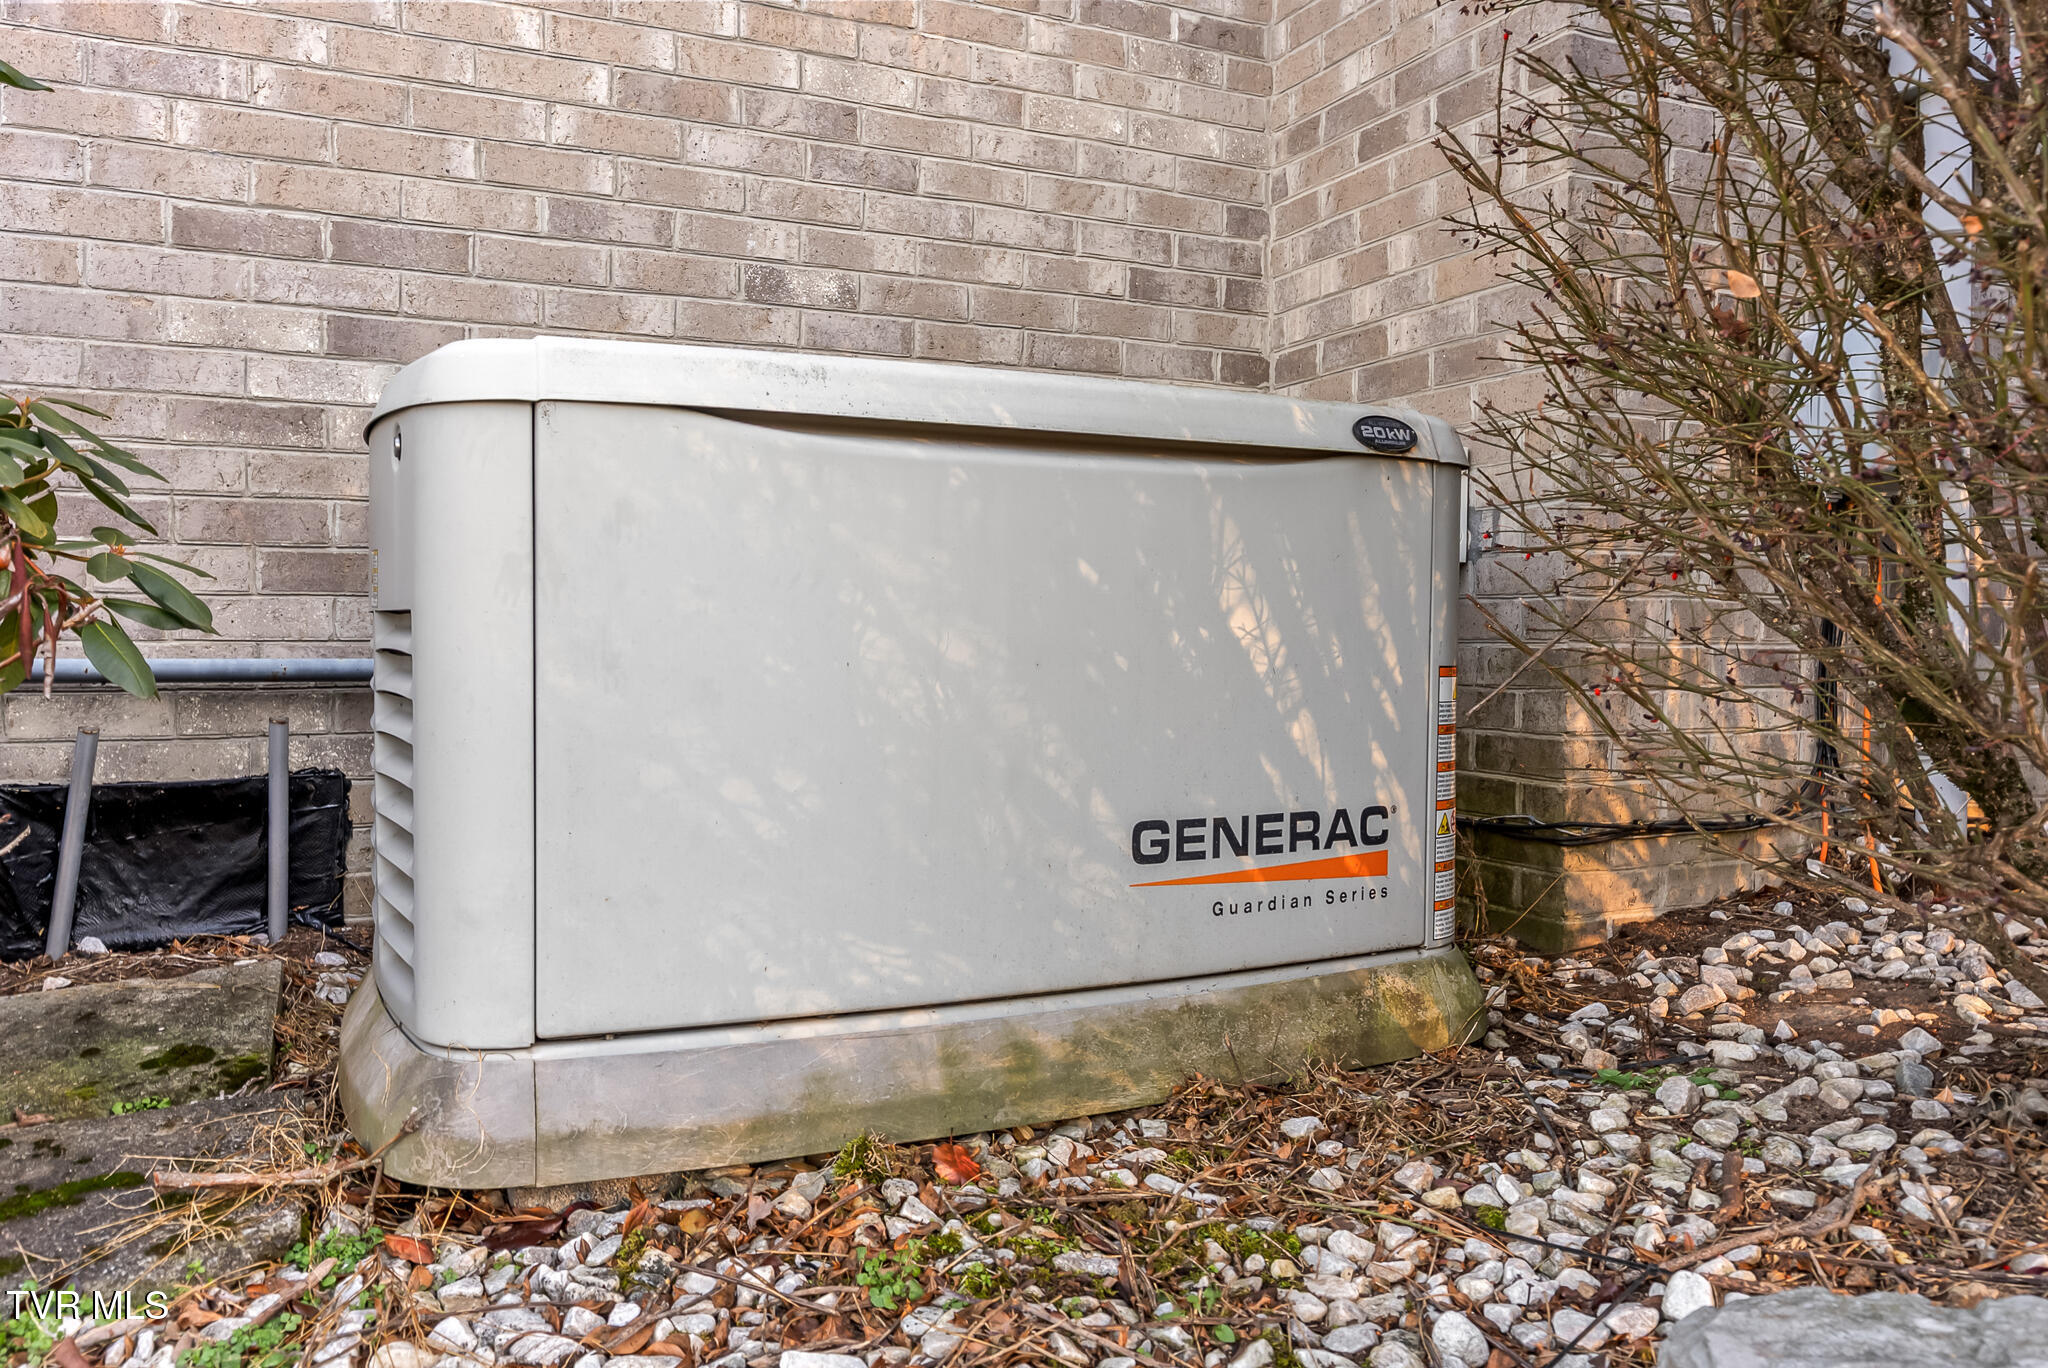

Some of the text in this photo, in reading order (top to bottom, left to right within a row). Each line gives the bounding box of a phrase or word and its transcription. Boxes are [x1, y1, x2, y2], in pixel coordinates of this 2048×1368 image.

[1361, 425, 1410, 440] 20kW
[1131, 805, 1389, 865] GENERAC
[1212, 886, 1388, 917] Guardian Series
